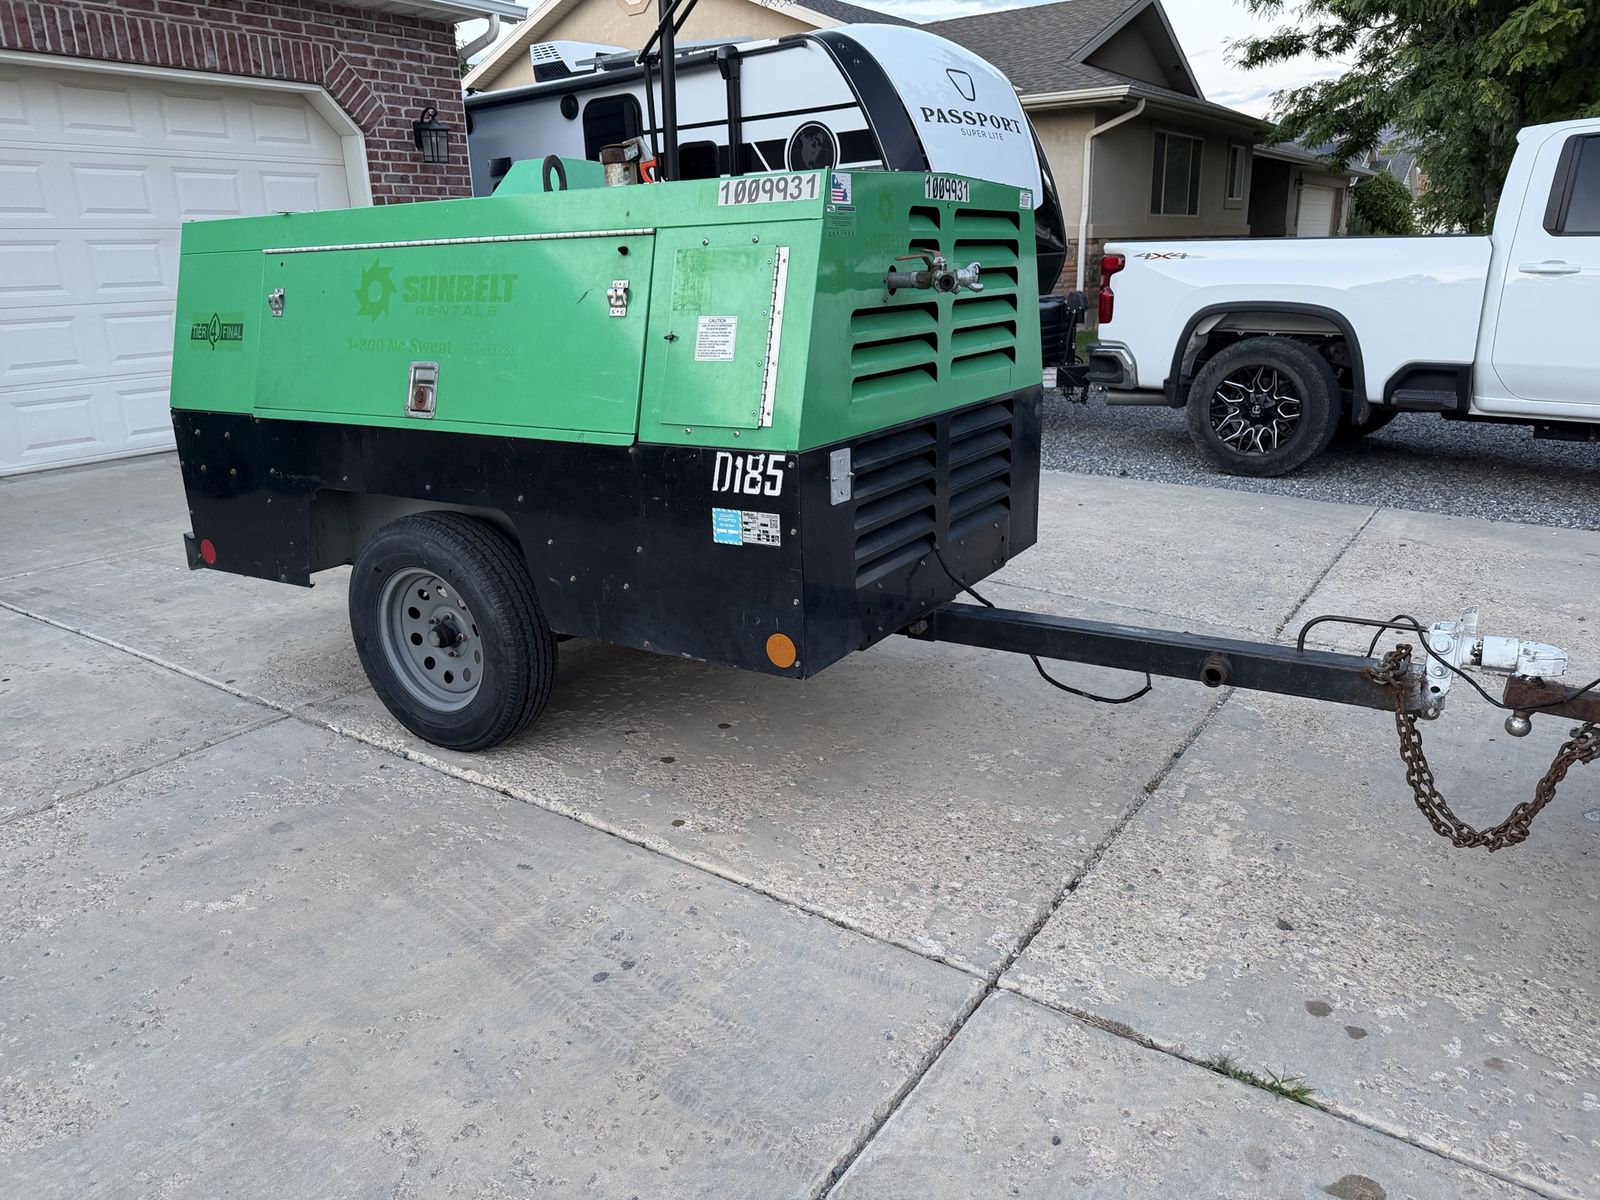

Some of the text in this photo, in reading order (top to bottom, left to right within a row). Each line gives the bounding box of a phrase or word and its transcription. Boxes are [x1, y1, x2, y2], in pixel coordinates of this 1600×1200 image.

[920, 106, 1021, 135] PASSPORT
[960, 128, 1004, 141] SUPER LITE
[720, 173, 816, 205] 1009931
[926, 175, 969, 202] 1009931
[401, 273, 519, 303] SUNBELT
[416, 305, 497, 318] RENTALS
[193, 326, 208, 339] TIER
[222, 325, 242, 339] FINAL
[346, 338, 385, 353] 1-800
[410, 337, 452, 355] Sweat
[711, 451, 786, 497] D185
